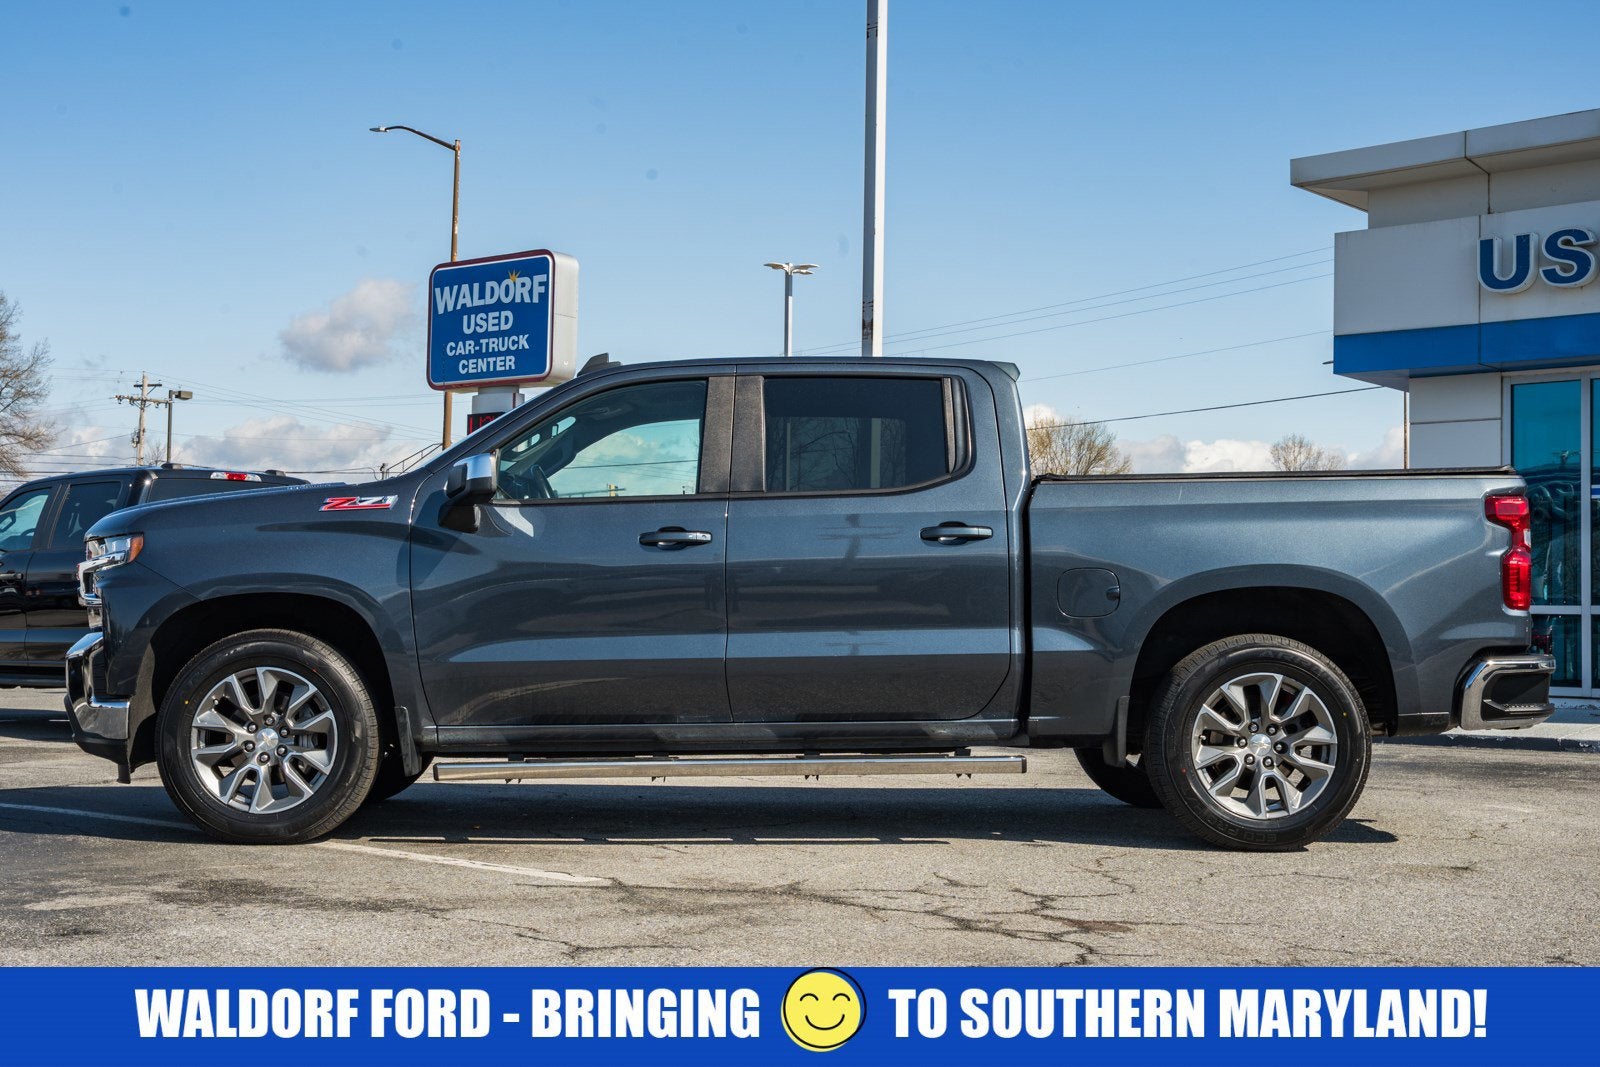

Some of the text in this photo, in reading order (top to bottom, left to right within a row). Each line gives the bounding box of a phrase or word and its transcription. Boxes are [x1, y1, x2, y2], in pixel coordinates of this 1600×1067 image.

[1478, 228, 1599, 294] US
[435, 274, 547, 315] WALDORF
[463, 311, 513, 335] USED
[447, 334, 529, 357] CAR-TRUCK
[459, 355, 515, 374] CENTER
[319, 495, 398, 511] Z71
